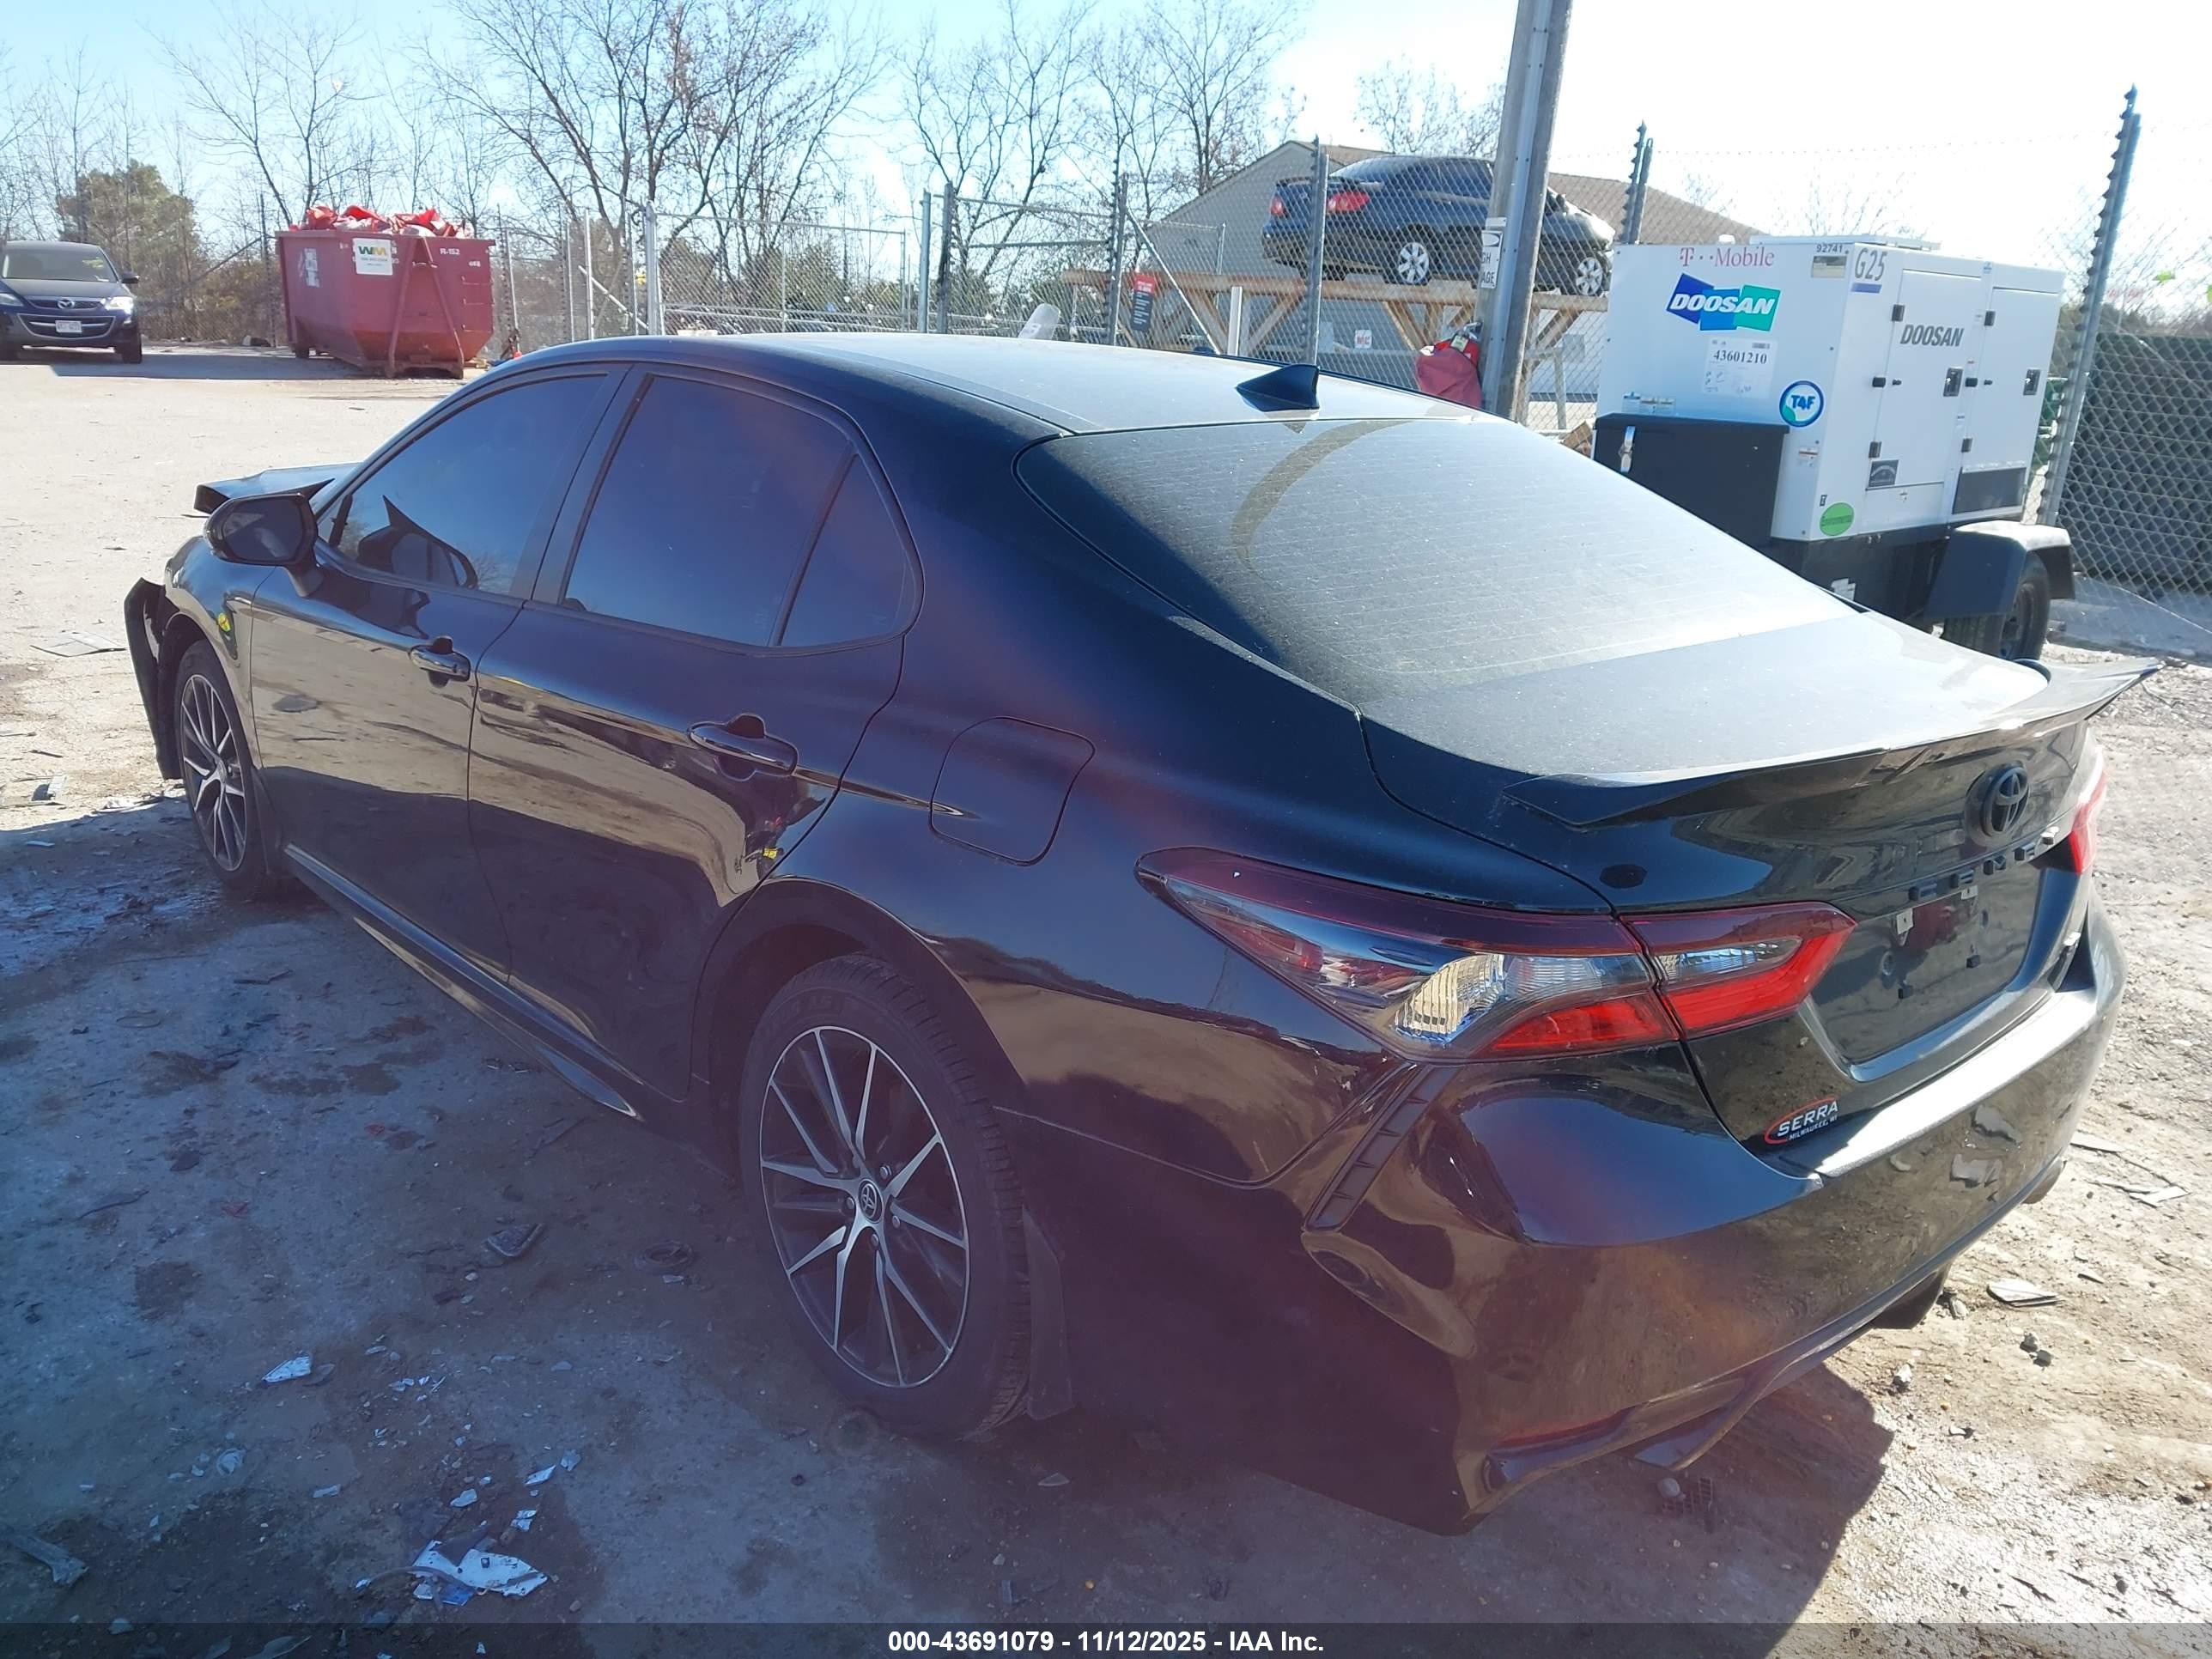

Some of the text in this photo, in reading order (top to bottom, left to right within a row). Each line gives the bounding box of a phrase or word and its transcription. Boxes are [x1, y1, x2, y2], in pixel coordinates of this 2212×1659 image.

[1816, 244, 1843, 253] 92741
[1855, 247, 1888, 282] G25
[1669, 293, 1776, 315] DOOSAN
[1899, 324, 1965, 347] DOOSAN
[1713, 349, 1767, 364] 43601210
[1777, 1100, 1838, 1138] SERRA
